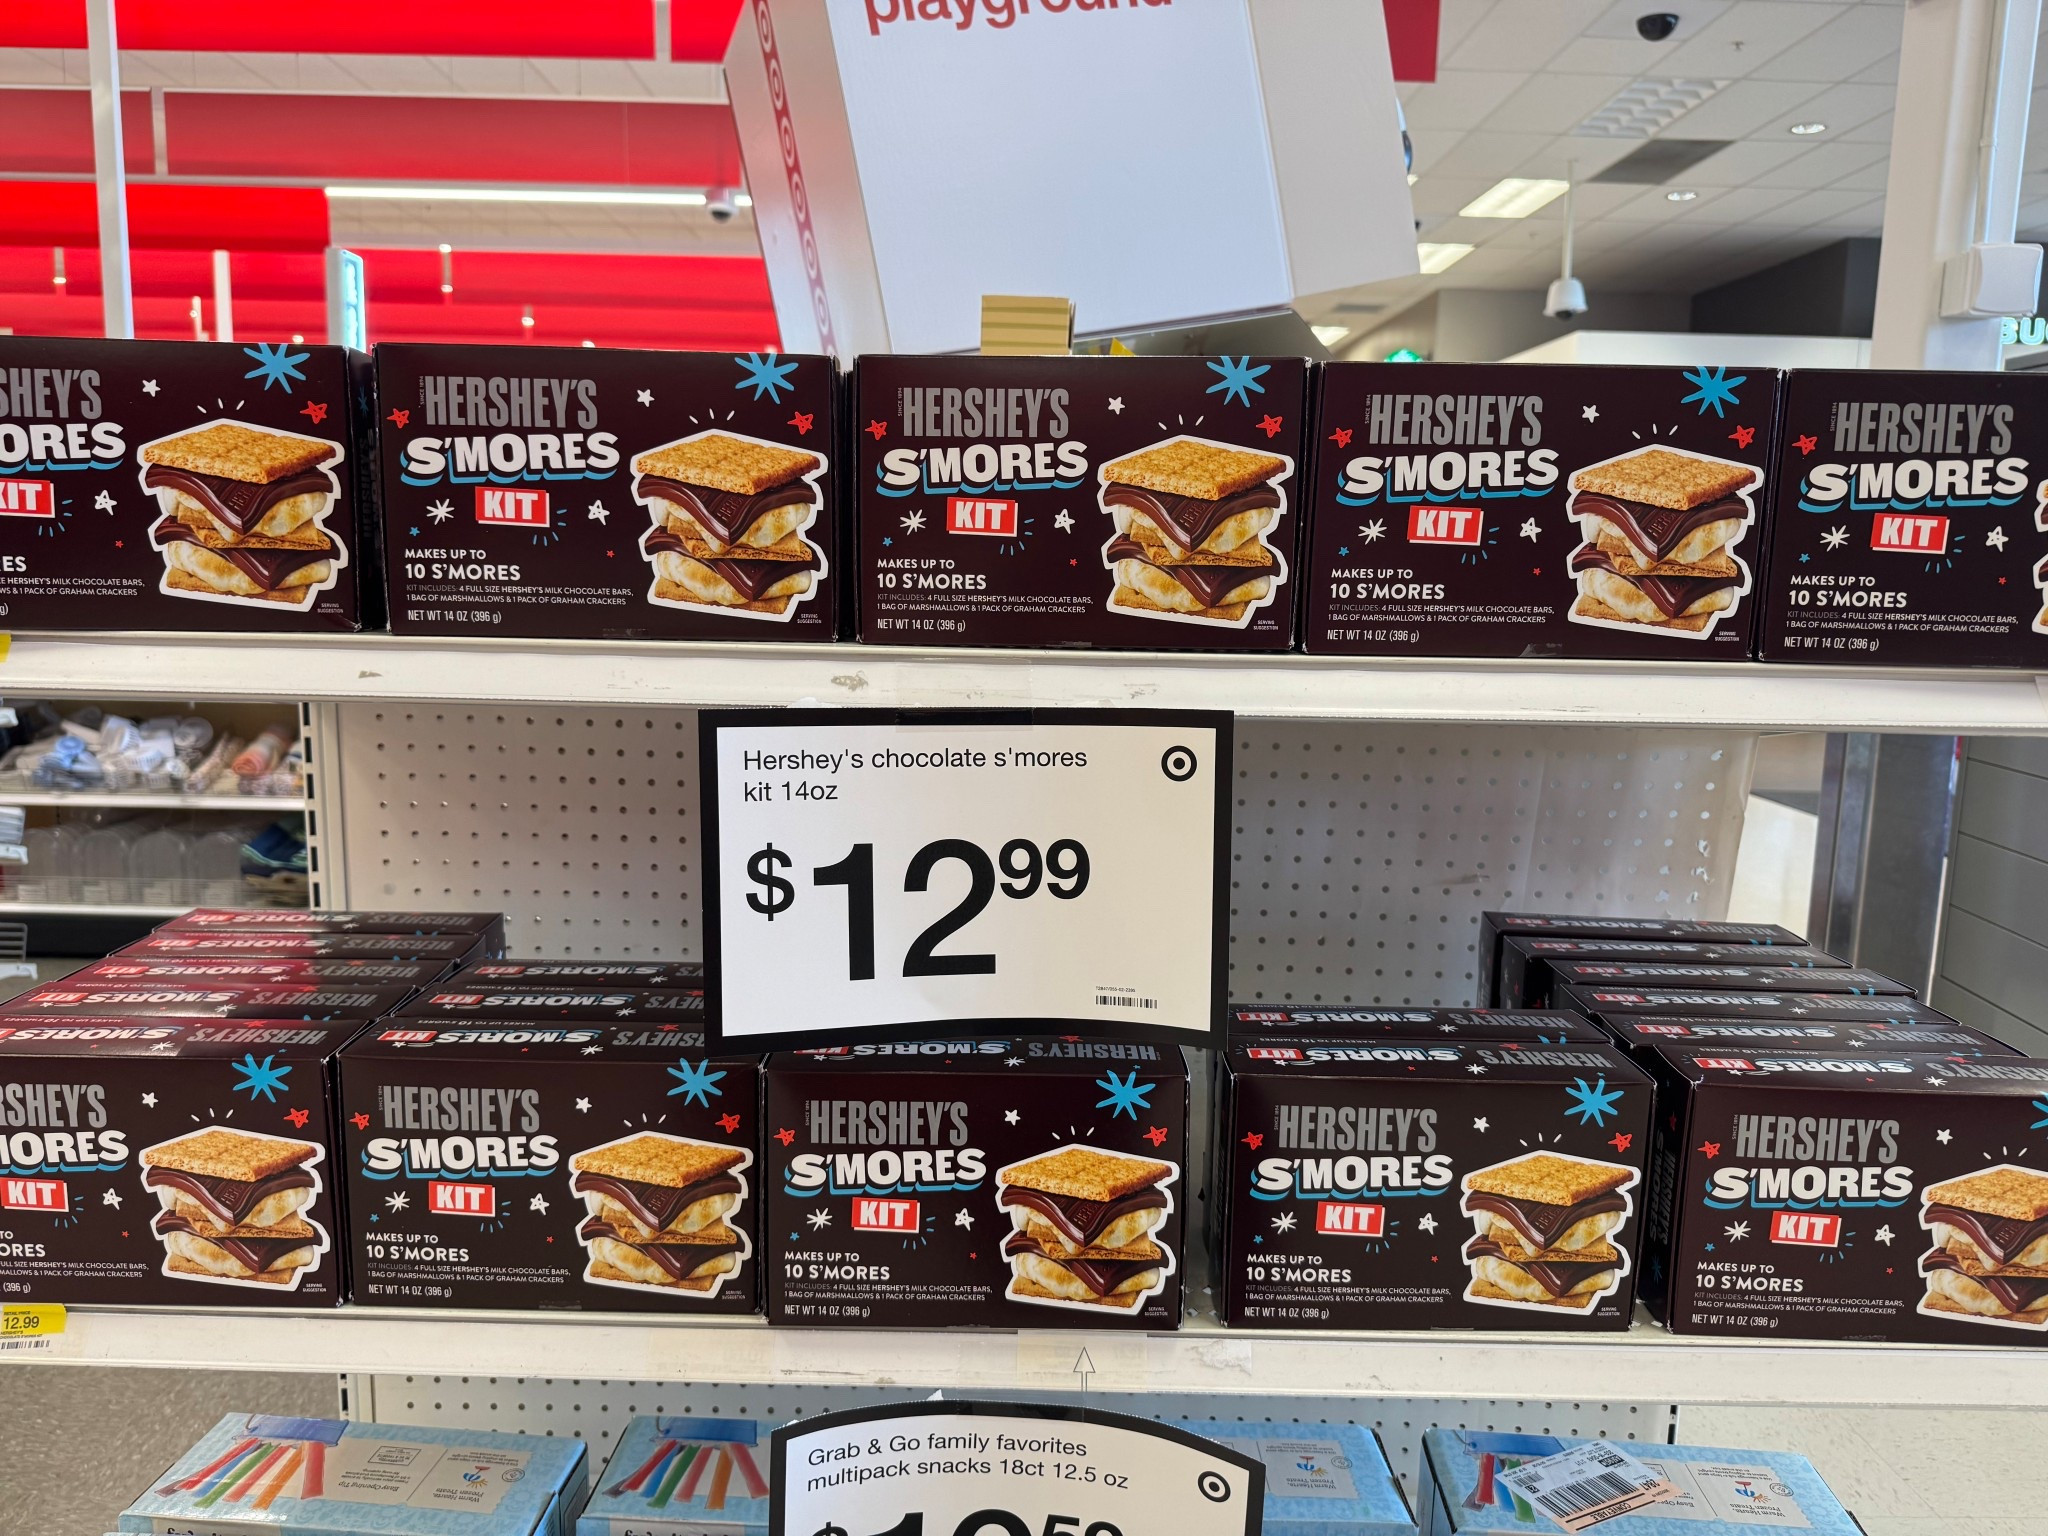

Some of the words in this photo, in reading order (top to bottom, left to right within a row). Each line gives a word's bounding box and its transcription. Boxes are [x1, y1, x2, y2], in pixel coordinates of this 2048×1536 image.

[422, 373, 597, 429] HERSHEY'S
[904, 388, 1069, 438] HERSHEY'S
[1370, 394, 1543, 446] HERSHEY'S
[1835, 402, 2015, 455] HERSHEY'S
[404, 432, 620, 477] S'MORES
[883, 441, 1088, 486] S'MORES
[1344, 450, 1558, 494] S'MORES
[1807, 458, 2029, 503] S'MORES
[484, 490, 538, 520] KIT
[956, 501, 1007, 529] KIT
[1417, 509, 1472, 538] KIT
[1880, 518, 1937, 546] KIT
[404, 548, 446, 558] MAKES
[450, 549, 466, 558] UP
[470, 550, 486, 559] TO
[404, 563, 424, 578] 10
[432, 563, 520, 580] S'MORES
[878, 559, 917, 568] MAKES
[921, 559, 936, 568] UP
[939, 560, 954, 569] TO
[878, 574, 896, 588] 10
[903, 573, 986, 589] S'MORES
[1332, 568, 1374, 578] MAKES
[1378, 568, 1394, 578] UP
[1397, 569, 1413, 578] TO
[1791, 575, 1834, 585] MAKES
[1838, 576, 1855, 586] UP
[1858, 577, 1874, 586] TO
[1331, 583, 1350, 598] 10
[1357, 583, 1444, 599] S'MORES
[1790, 590, 1810, 605] 10
[1816, 590, 1906, 607] S'MORES
[878, 619, 893, 629] NET
[895, 619, 909, 629] WT
[912, 619, 921, 629] 14
[924, 619, 934, 630] OZ
[937, 619, 955, 631] (396
[958, 620, 966, 632] g)
[744, 750, 864, 773] Hershey's
[872, 748, 985, 768] chocolate
[994, 748, 1087, 767] s'mores
[744, 782, 772, 801] kit
[781, 781, 838, 800] 14oz
[82, 992, 231, 1002] S'MORES
[248, 992, 378, 1006] HERSHEY'S
[438, 994, 480, 1004] KIT
[481, 994, 626, 1006] S'MORES
[1247, 1013, 1283, 1021] KIT
[1290, 1012, 1432, 1022] S'MORES
[1448, 1013, 1575, 1028] HERSHEY'S
[9, 1028, 174, 1040] S'MORES
[187, 1028, 328, 1044] HERSHEY'S
[392, 1031, 432, 1041] KIT
[435, 1030, 594, 1043] S'MORES
[1691, 1027, 1836, 1037] S'MORES
[853, 1043, 1006, 1055] S'MORES
[1028, 1042, 1156, 1060] HERSHEY'S
[1258, 1049, 1297, 1059] KIT
[1306, 1049, 1460, 1061] S'MORES
[1476, 1050, 1614, 1068] HERSHEY'S
[1702, 1059, 1748, 1069] KIT
[1755, 1059, 1914, 1073] S'MORES
[383, 1087, 539, 1132] HERSHEY'S
[810, 1100, 967, 1146] HERSHEY'S
[1280, 1106, 1437, 1152] HERSHEY'S
[1736, 1115, 1900, 1163] HERSHEY'S
[367, 1135, 559, 1173] S'MORES
[790, 1148, 986, 1188] S'MORES
[1257, 1154, 1452, 1192] S'MORES
[8, 1182, 56, 1206] KIT
[1712, 1166, 1913, 1205] S'MORES
[437, 1185, 485, 1210] KIT
[860, 1201, 909, 1226] KIT
[1325, 1205, 1374, 1230] KIT
[1778, 1215, 1830, 1240] KIT
[366, 1234, 403, 1242] MAKES
[367, 1246, 384, 1259] 10
[390, 1246, 469, 1261] S'MORES
[785, 1252, 823, 1260] MAKES
[827, 1253, 842, 1261] UP
[845, 1253, 859, 1261] TO
[1248, 1255, 1286, 1263] MAKES
[785, 1265, 803, 1278] 10
[809, 1265, 890, 1279] S'MORES
[1247, 1268, 1265, 1281] 10
[1271, 1268, 1351, 1282] S'MORES
[1698, 1262, 1737, 1271] MAKES
[1741, 1264, 1756, 1272] UP
[1759, 1265, 1774, 1273] TO
[1697, 1275, 1715, 1288] 10
[1721, 1276, 1803, 1291] S'MORES
[4, 1316, 39, 1329] 12.99
[808, 1442, 860, 1465] Grab
[868, 1439, 882, 1454] &
[890, 1436, 920, 1451] Go
[928, 1433, 990, 1453] family
[997, 1434, 1087, 1456] favorites
[808, 1460, 910, 1491] multipack
[918, 1458, 991, 1474] snacks
[1000, 1459, 1044, 1476] 18ct
[1053, 1462, 1096, 1482] 12.5
[1104, 1474, 1128, 1489] oz
[1590, 1502, 1632, 1521] CONVEYABLE
